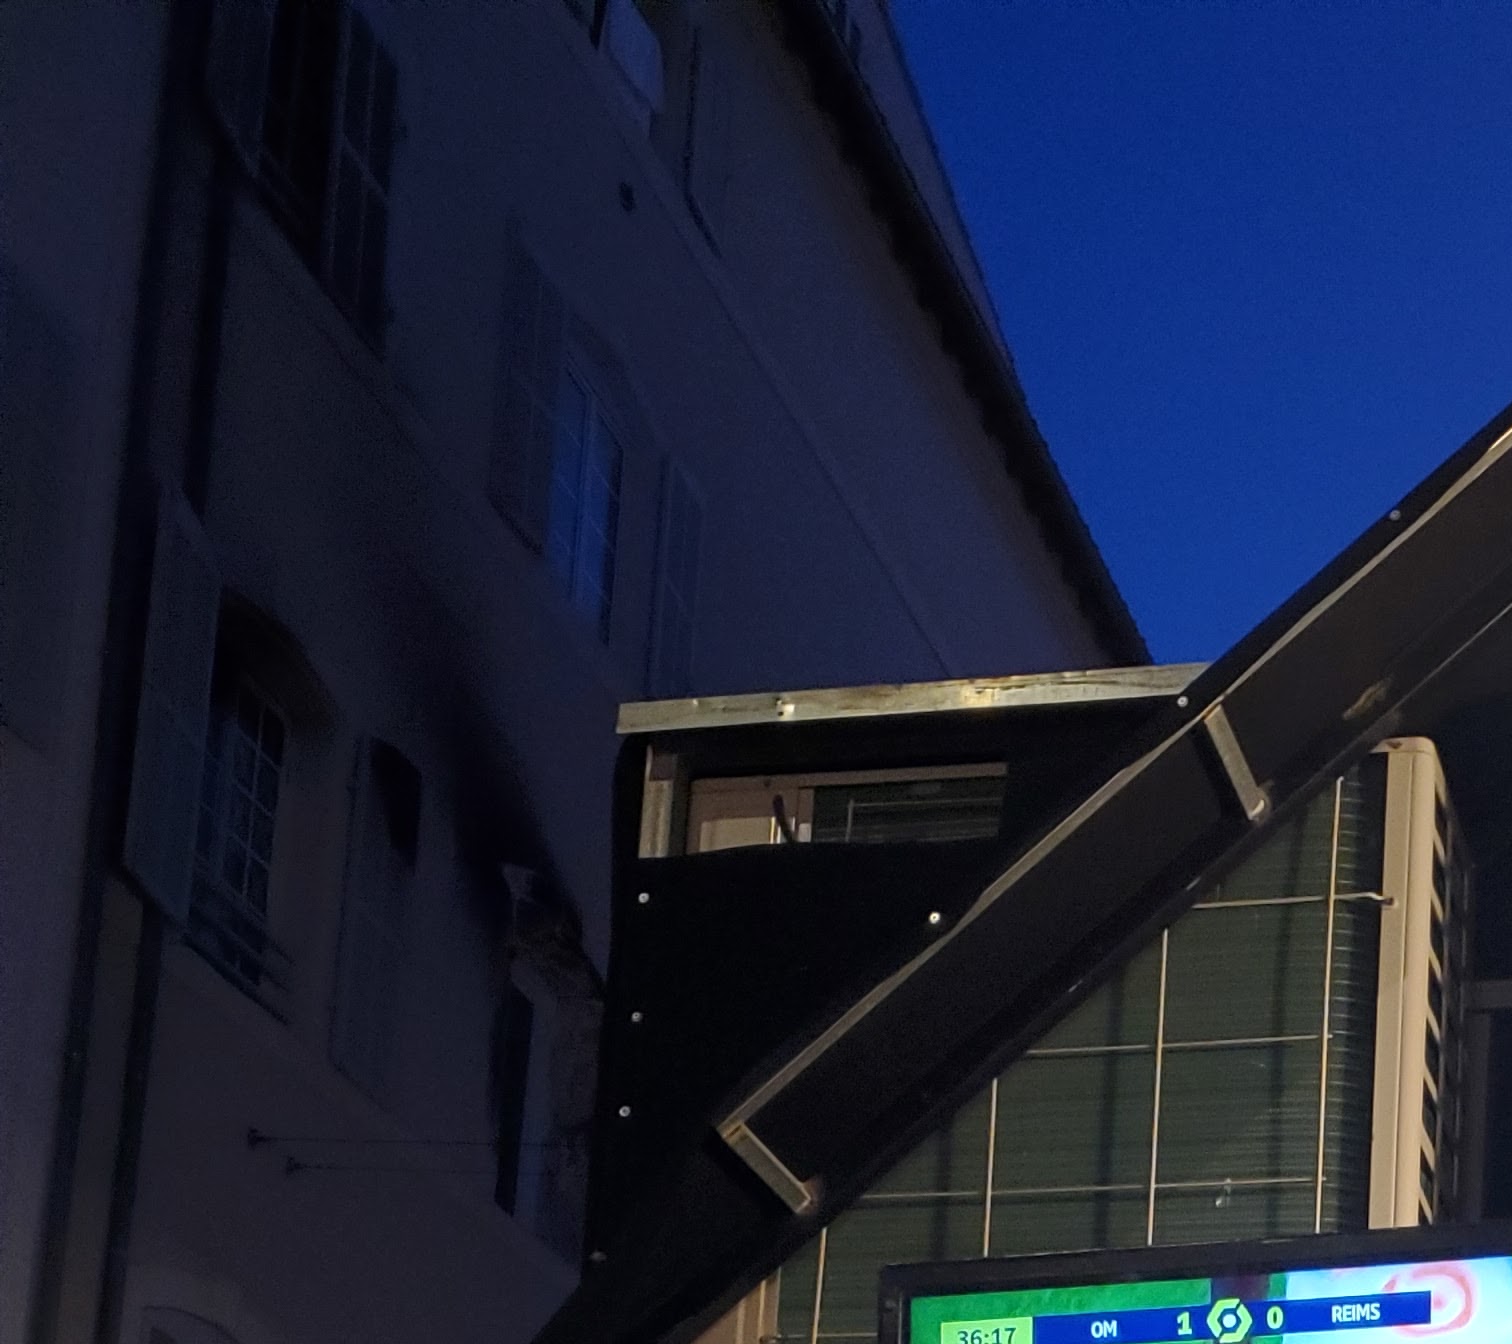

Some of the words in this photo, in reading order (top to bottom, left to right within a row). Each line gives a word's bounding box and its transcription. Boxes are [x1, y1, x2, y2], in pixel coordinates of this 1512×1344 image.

[1090, 1319, 1118, 1338] OM
[1176, 1312, 1193, 1335] 1
[1266, 1306, 1284, 1329] 0
[1331, 1303, 1381, 1323] REIMS
